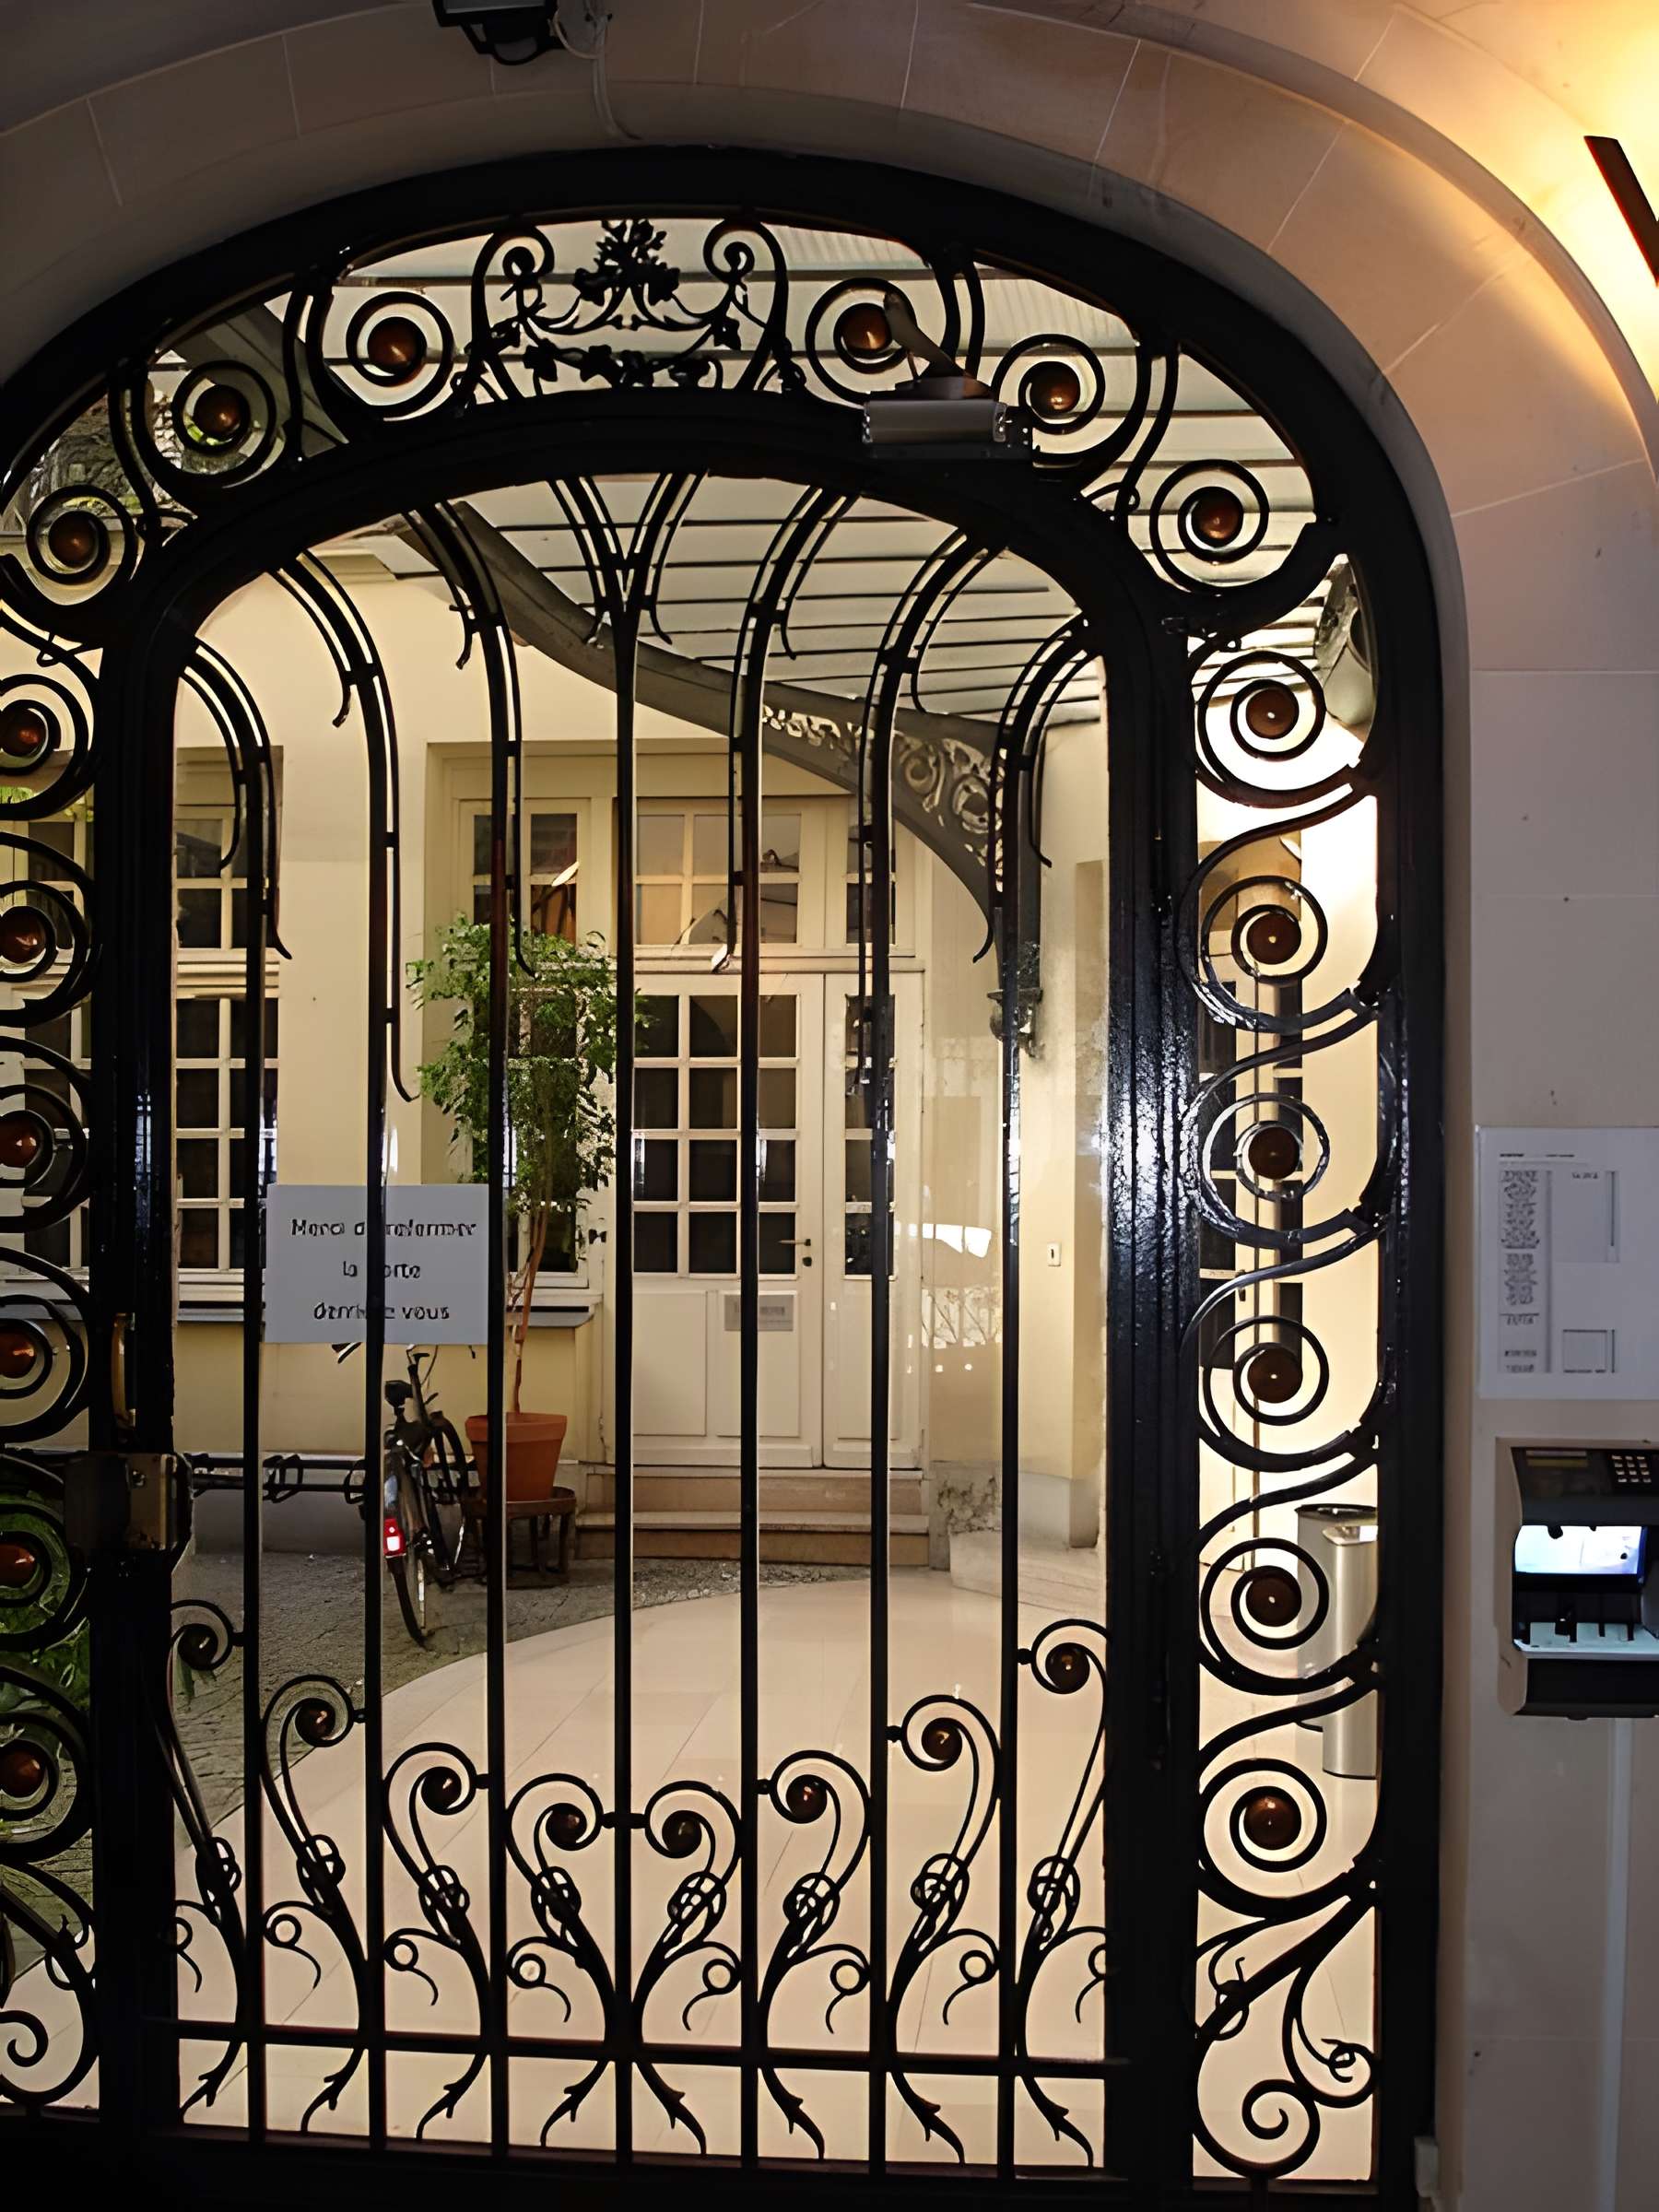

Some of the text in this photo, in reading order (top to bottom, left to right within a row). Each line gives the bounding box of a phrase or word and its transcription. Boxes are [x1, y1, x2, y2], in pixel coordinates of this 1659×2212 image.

[291, 1218, 345, 1236] Merci
[343, 1261, 358, 1277] la
[402, 1306, 450, 1320] vous
